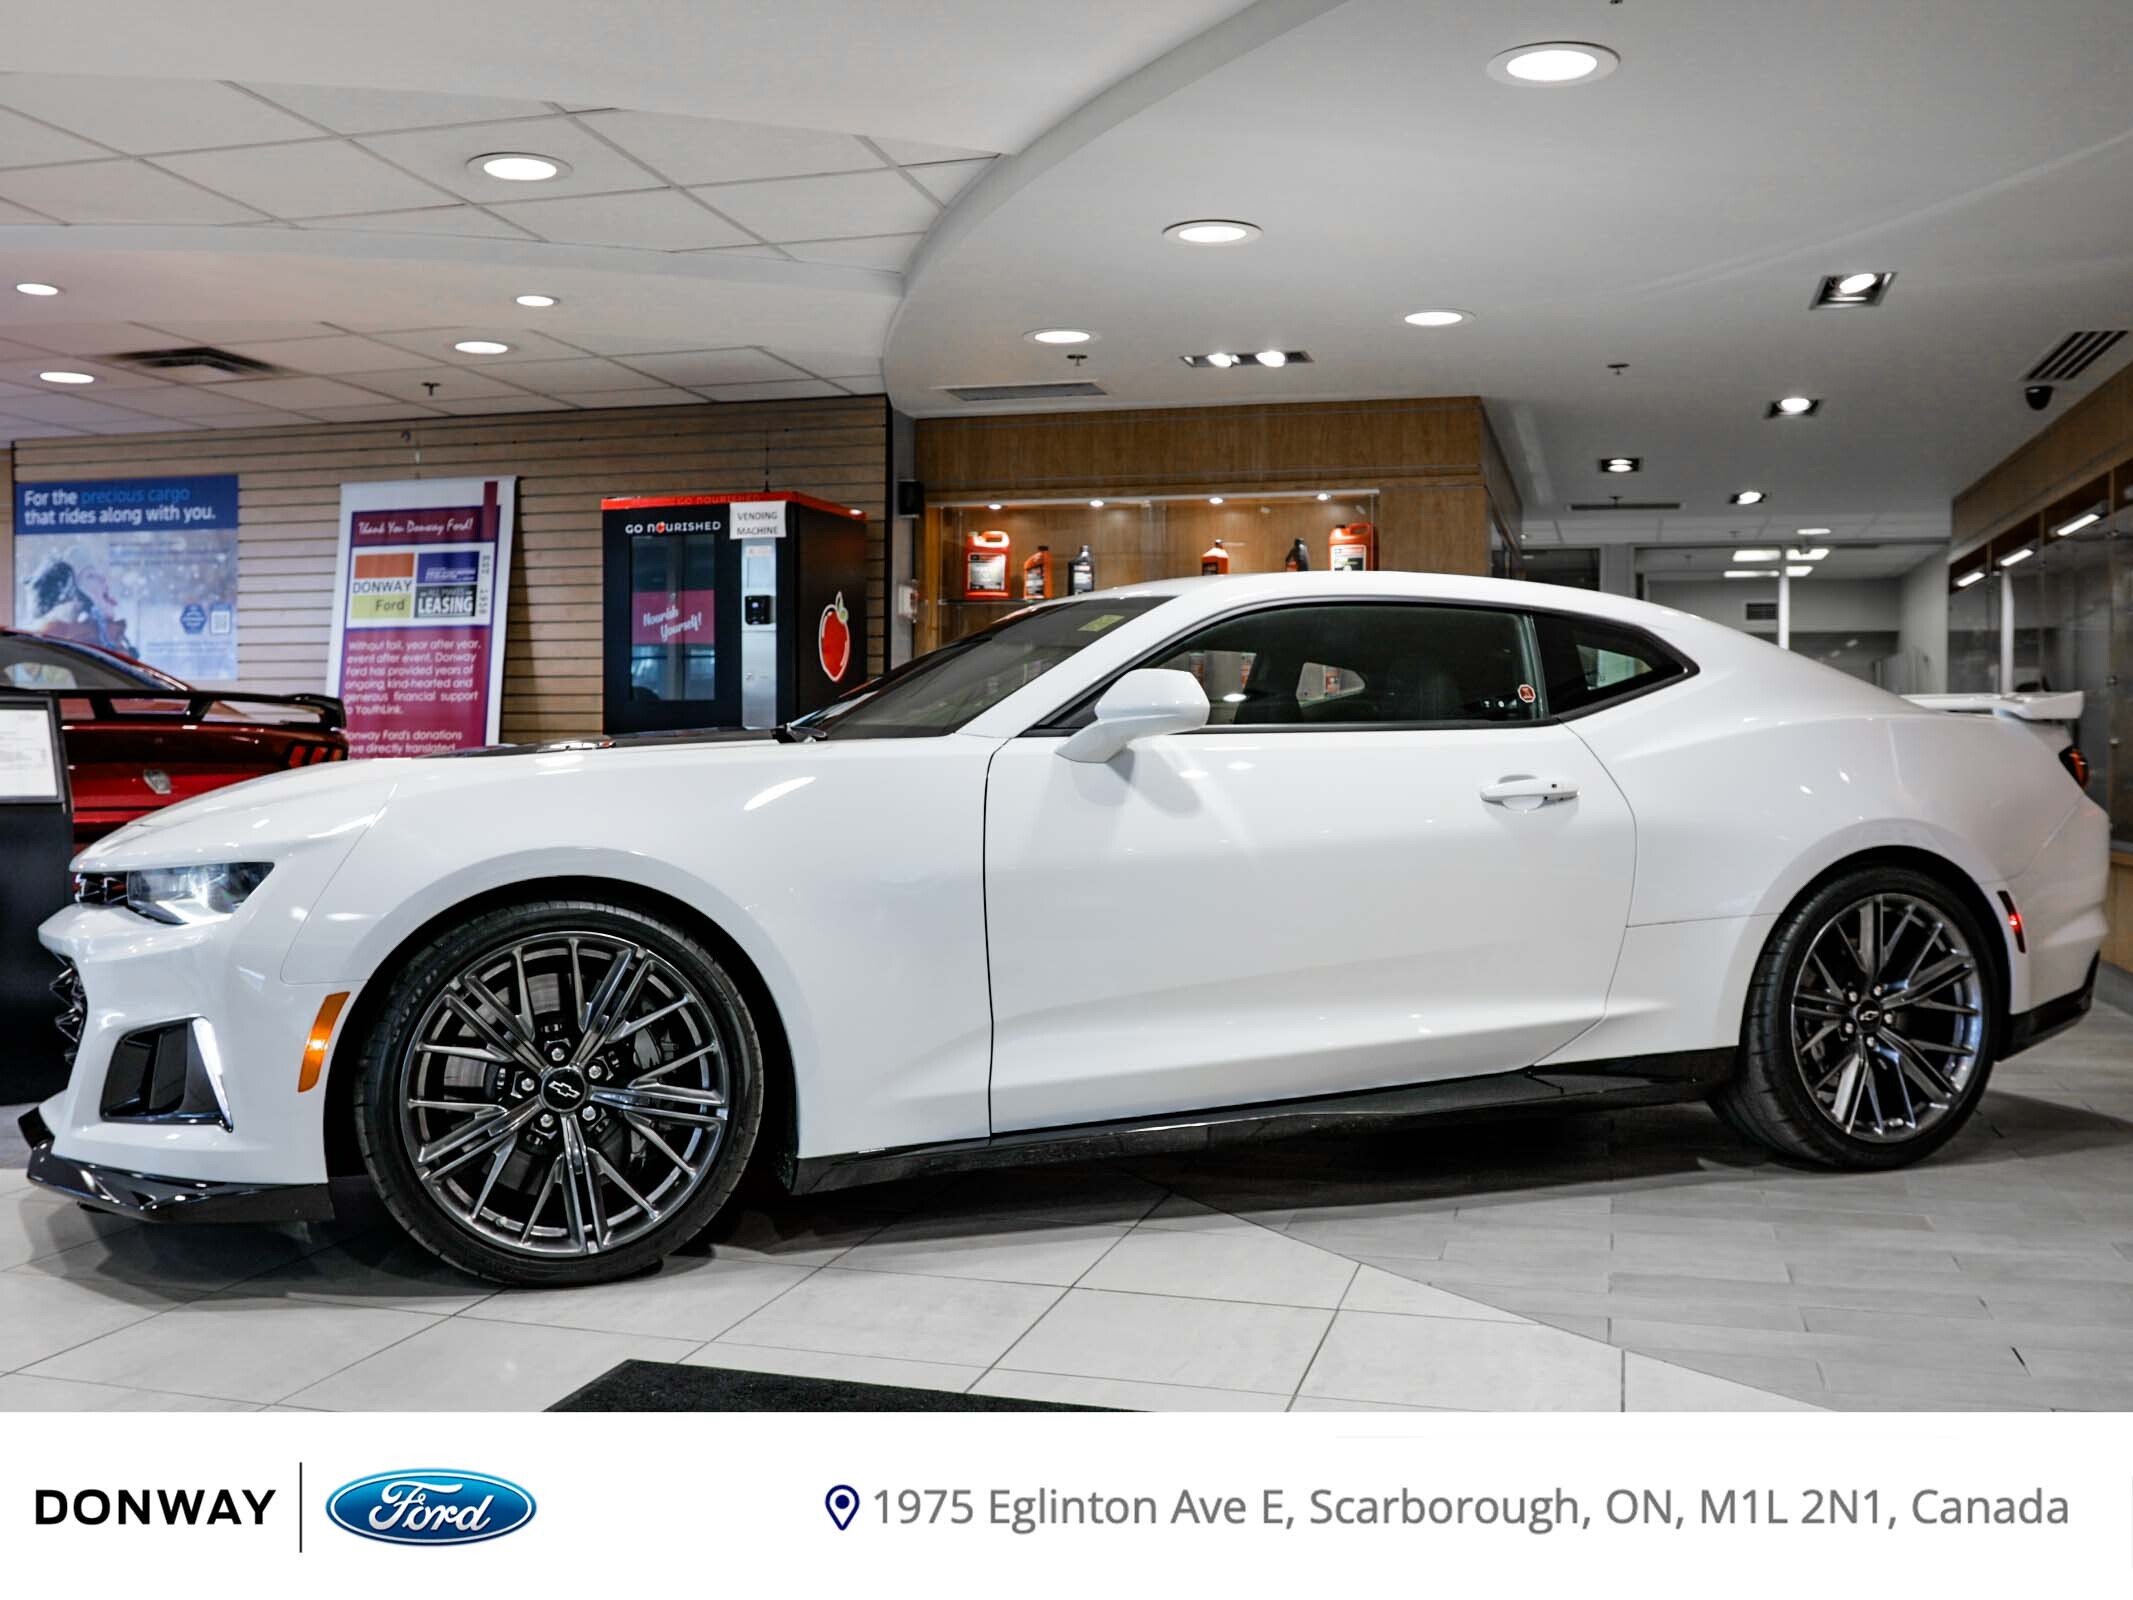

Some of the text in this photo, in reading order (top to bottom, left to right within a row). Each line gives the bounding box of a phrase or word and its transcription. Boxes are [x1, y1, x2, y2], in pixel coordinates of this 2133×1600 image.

[24, 487, 191, 506] For the precious cargo
[677, 495, 693, 505] GO
[24, 505, 216, 526] that rides along with you.
[737, 511, 778, 521] VENDING
[358, 517, 474, 536] Thank You Donway Ford!
[625, 523, 643, 534] GO
[737, 526, 778, 536] MACHINE
[352, 579, 412, 594] DONWAY
[375, 598, 405, 612] Ford
[417, 596, 473, 614] LEASING
[643, 604, 680, 626] Nourish
[660, 610, 702, 642] Yourself!
[406, 641, 427, 652] year
[430, 639, 453, 650] after
[347, 653, 376, 664] event
[376, 653, 400, 664] after
[435, 652, 476, 664] Donway
[346, 665, 474, 678] Ford has provided years of
[344, 678, 473, 691] ongoing kind-hearted and
[343, 690, 479, 704] generous financial support
[412, 729, 462, 740] donations
[366, 743, 403, 755] directly
